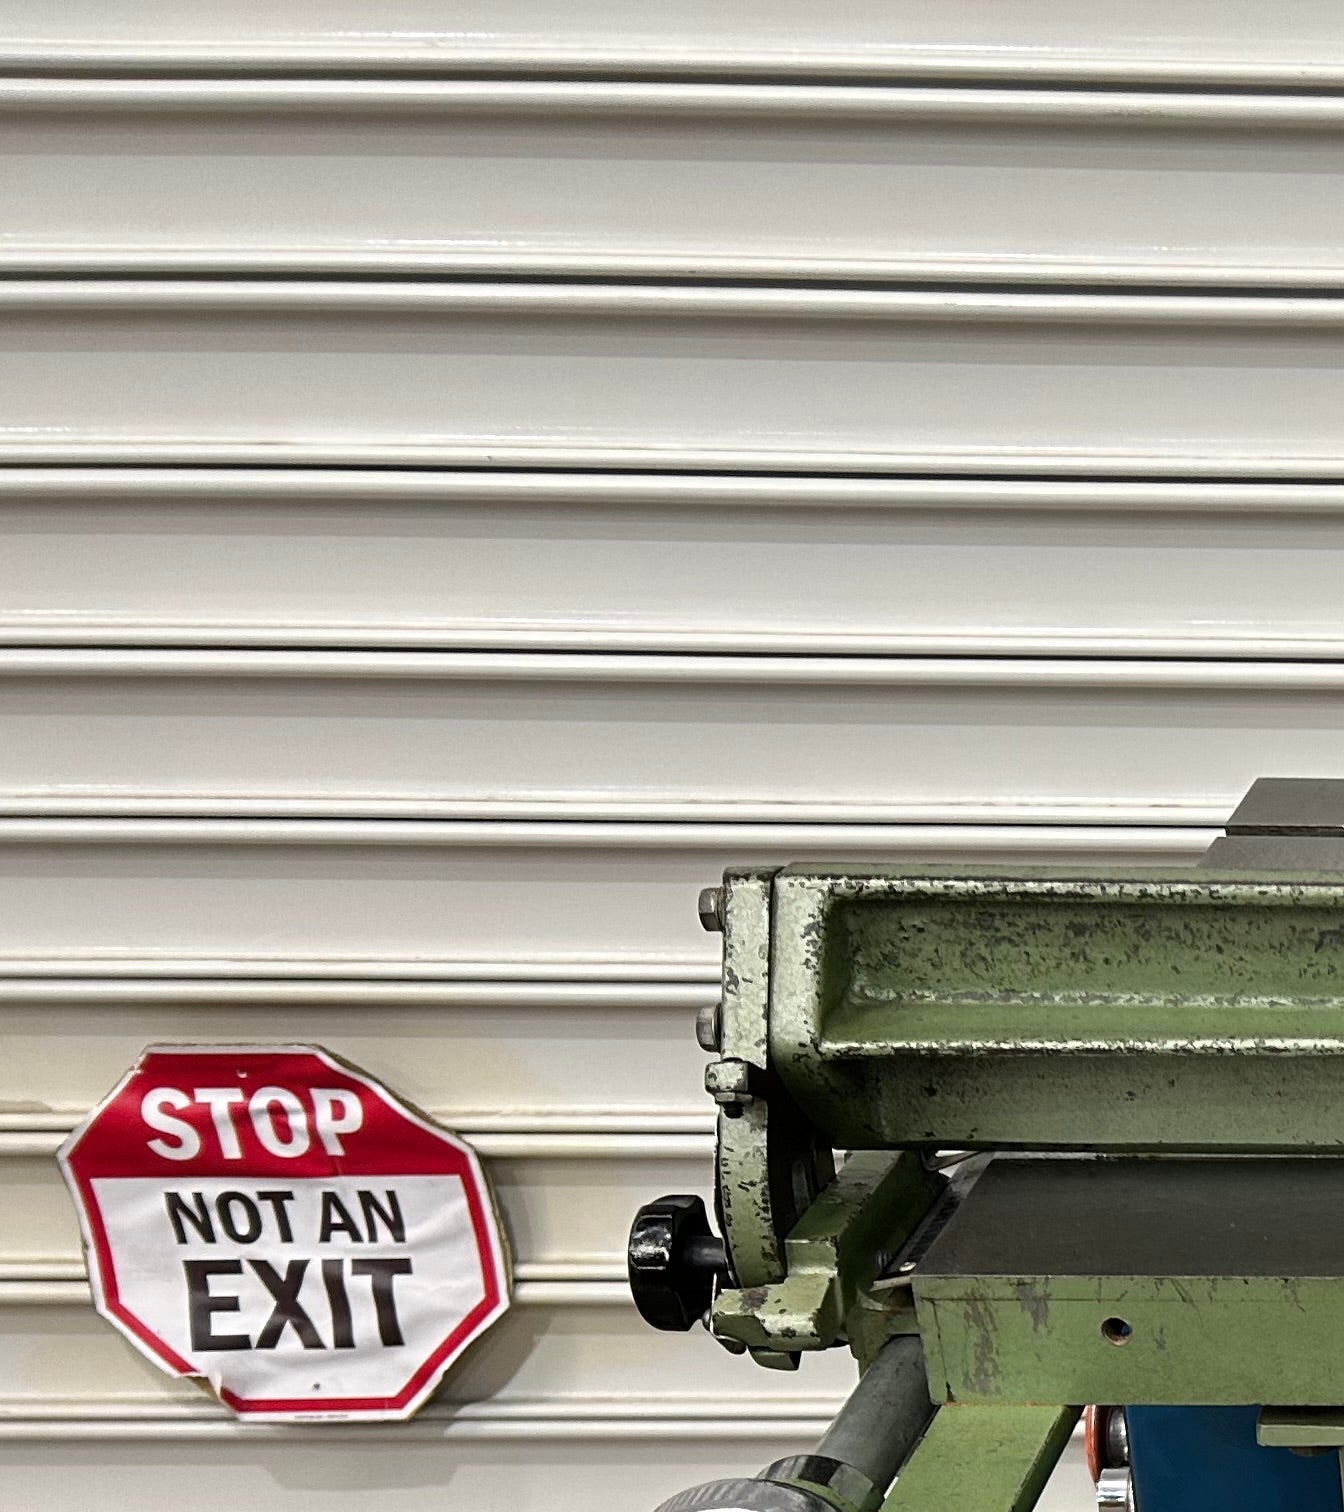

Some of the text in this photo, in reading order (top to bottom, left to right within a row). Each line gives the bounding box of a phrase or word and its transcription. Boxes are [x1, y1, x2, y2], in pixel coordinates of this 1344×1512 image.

[140, 1087, 364, 1161] STOP
[163, 1190, 405, 1244] NOT AN
[183, 1258, 413, 1352] EXIT
